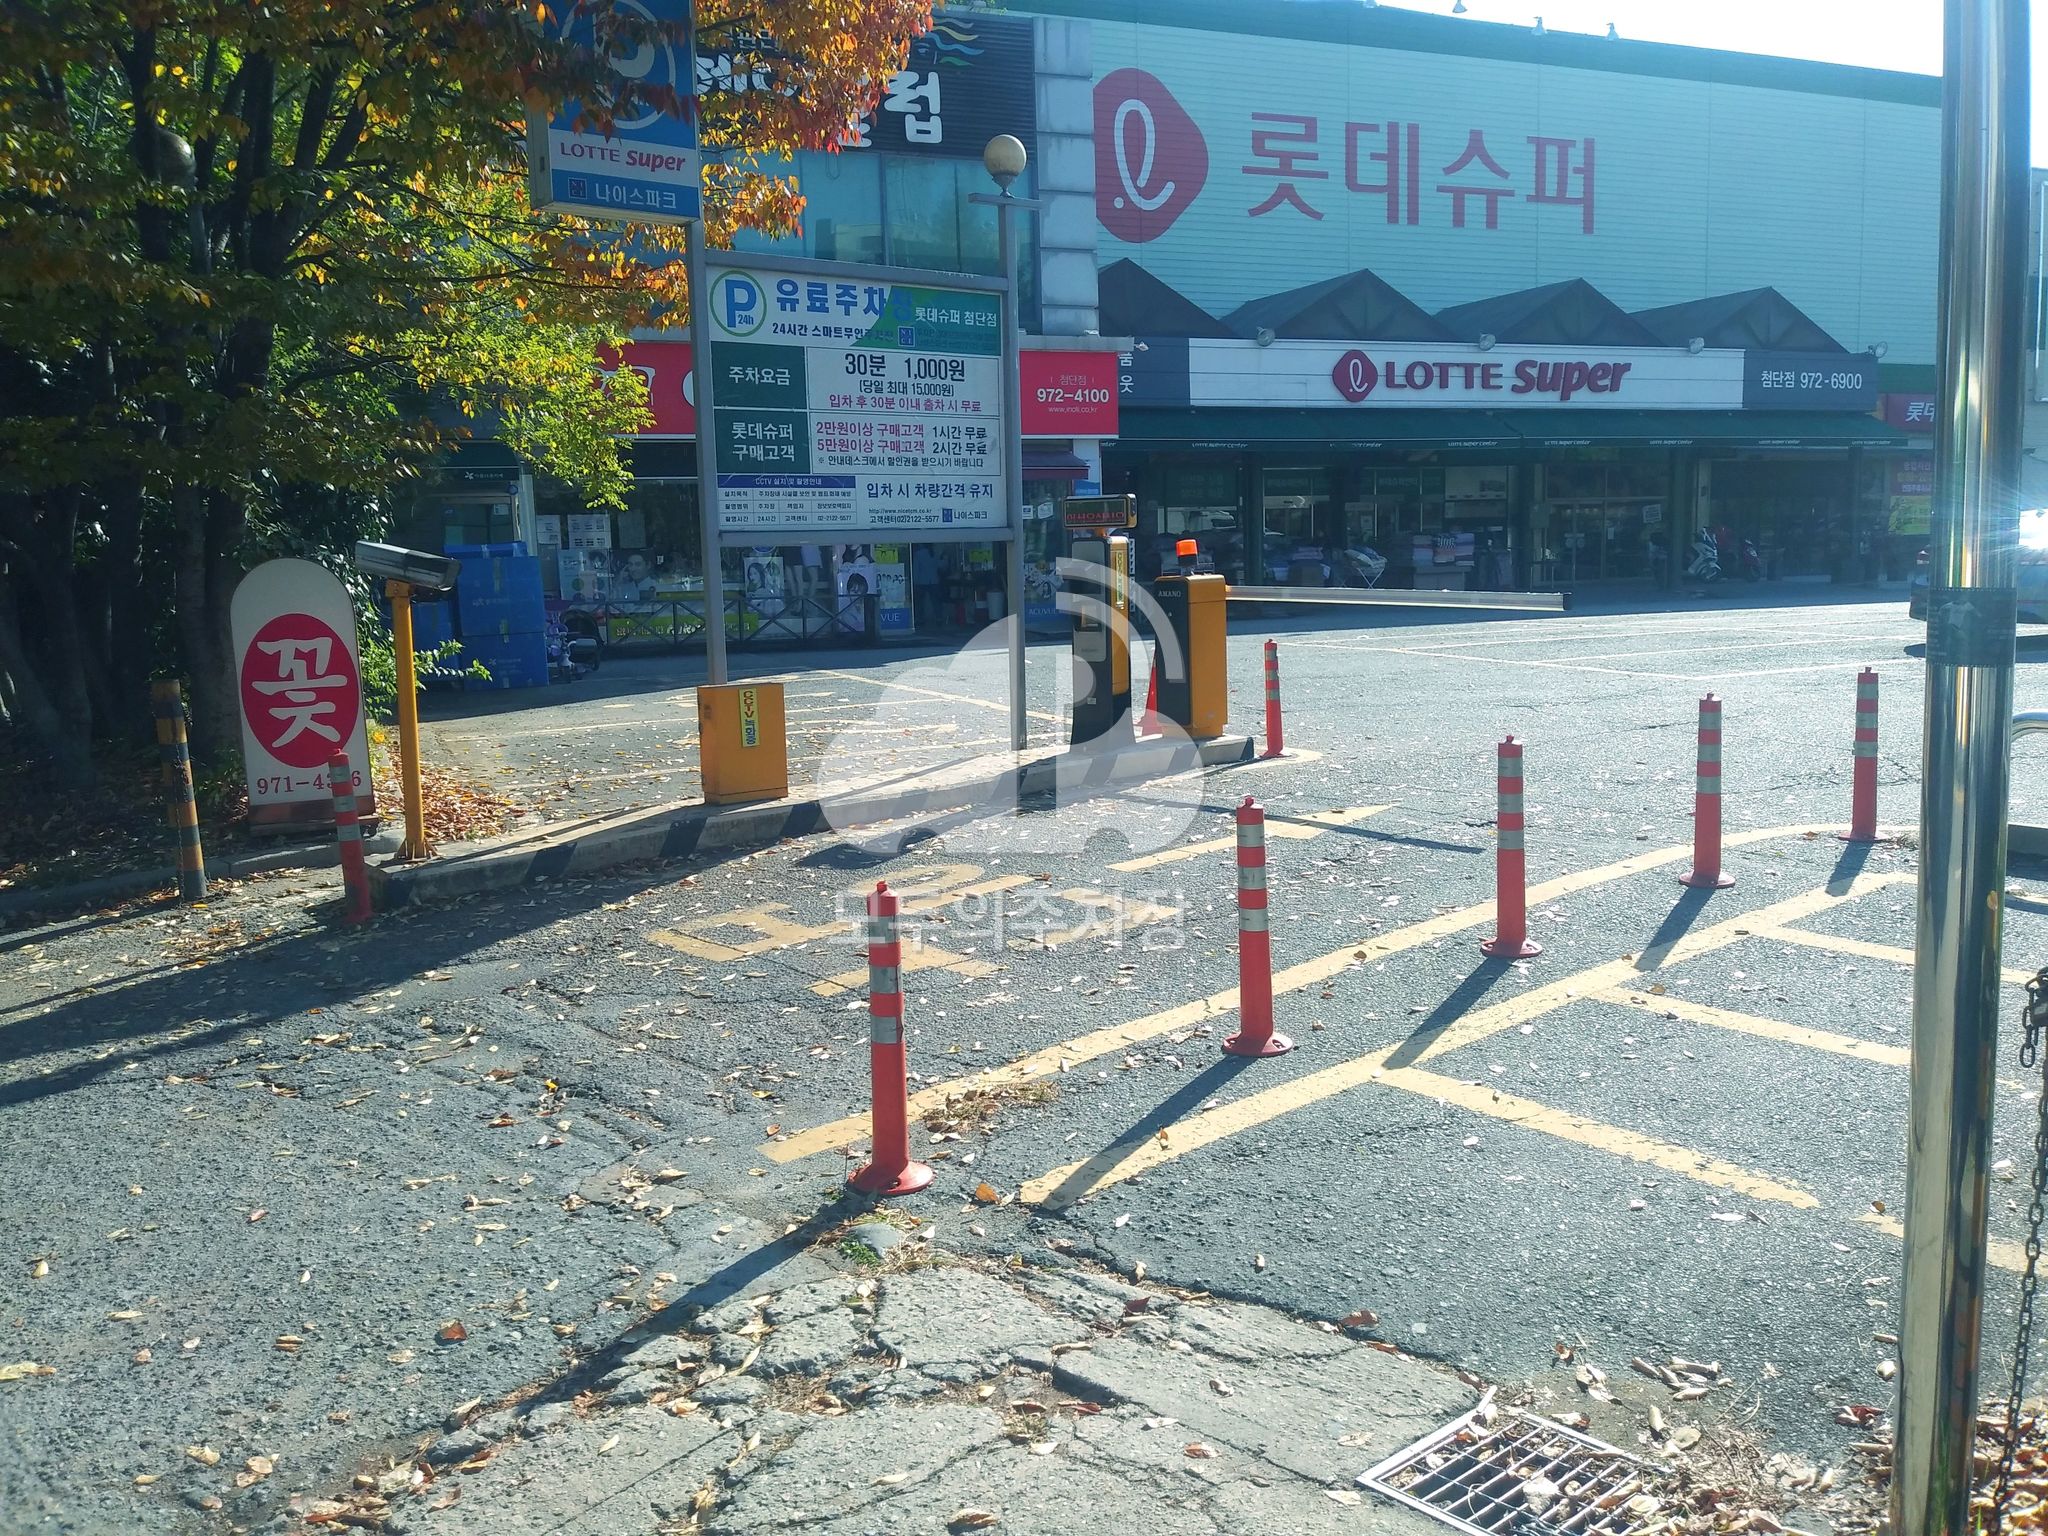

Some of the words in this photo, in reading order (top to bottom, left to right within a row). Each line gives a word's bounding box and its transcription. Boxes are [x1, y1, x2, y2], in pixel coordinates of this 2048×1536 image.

[560, 142, 621, 163] LOTTE
[1242, 111, 1595, 235] 롯데슈퍼
[595, 182, 677, 209] 나이스파크
[725, 279, 757, 328] P
[737, 313, 754, 325] 24h
[915, 306, 961, 325] 롯데슈퍼
[963, 311, 997, 327] 첨단점
[772, 322, 808, 337] 24시간
[728, 365, 791, 386] 주차요금
[844, 353, 886, 377] 30분
[904, 357, 965, 382] 1,000원
[1386, 361, 1504, 390] LOTTE
[886, 380, 908, 395] 최대
[1059, 374, 1087, 386] 첨단점
[1760, 369, 1796, 389] 첨단점
[1800, 371, 1862, 391] 972-6900
[829, 394, 853, 408] 입차
[855, 395, 869, 409] 후
[870, 396, 895, 410] 30분
[898, 397, 921, 411] 이내
[923, 399, 945, 412] 출차
[947, 400, 958, 412] 시
[960, 400, 982, 412] 무료
[1036, 388, 1109, 403] 972-4100
[731, 421, 794, 441] 롯데슈퍼
[816, 421, 873, 436] 2만원이상
[877, 423, 924, 437] 구매고객
[932, 425, 962, 440] 1시간
[964, 426, 988, 440] 무료
[732, 443, 795, 462] 구매고객
[817, 438, 874, 454] 5만원이상
[878, 440, 925, 454] 구매고객
[932, 441, 962, 456] 2시간
[965, 441, 988, 456] 무료
[828, 455, 885, 467] 안내데스크에서
[887, 457, 919, 468] 할인권을
[953, 457, 984, 469] 바랍니다
[755, 477, 772, 486] CCTV
[867, 483, 893, 499] 입차
[897, 483, 910, 499] 시
[914, 483, 965, 499] 차량간격
[969, 483, 993, 499] 유지
[953, 511, 988, 520] 나이스파크
[1158, 590, 1182, 598] AMANO
[251, 636, 348, 749] 꽃
[743, 690, 754, 718] CCTV
[256, 770, 362, 796] 971-436
